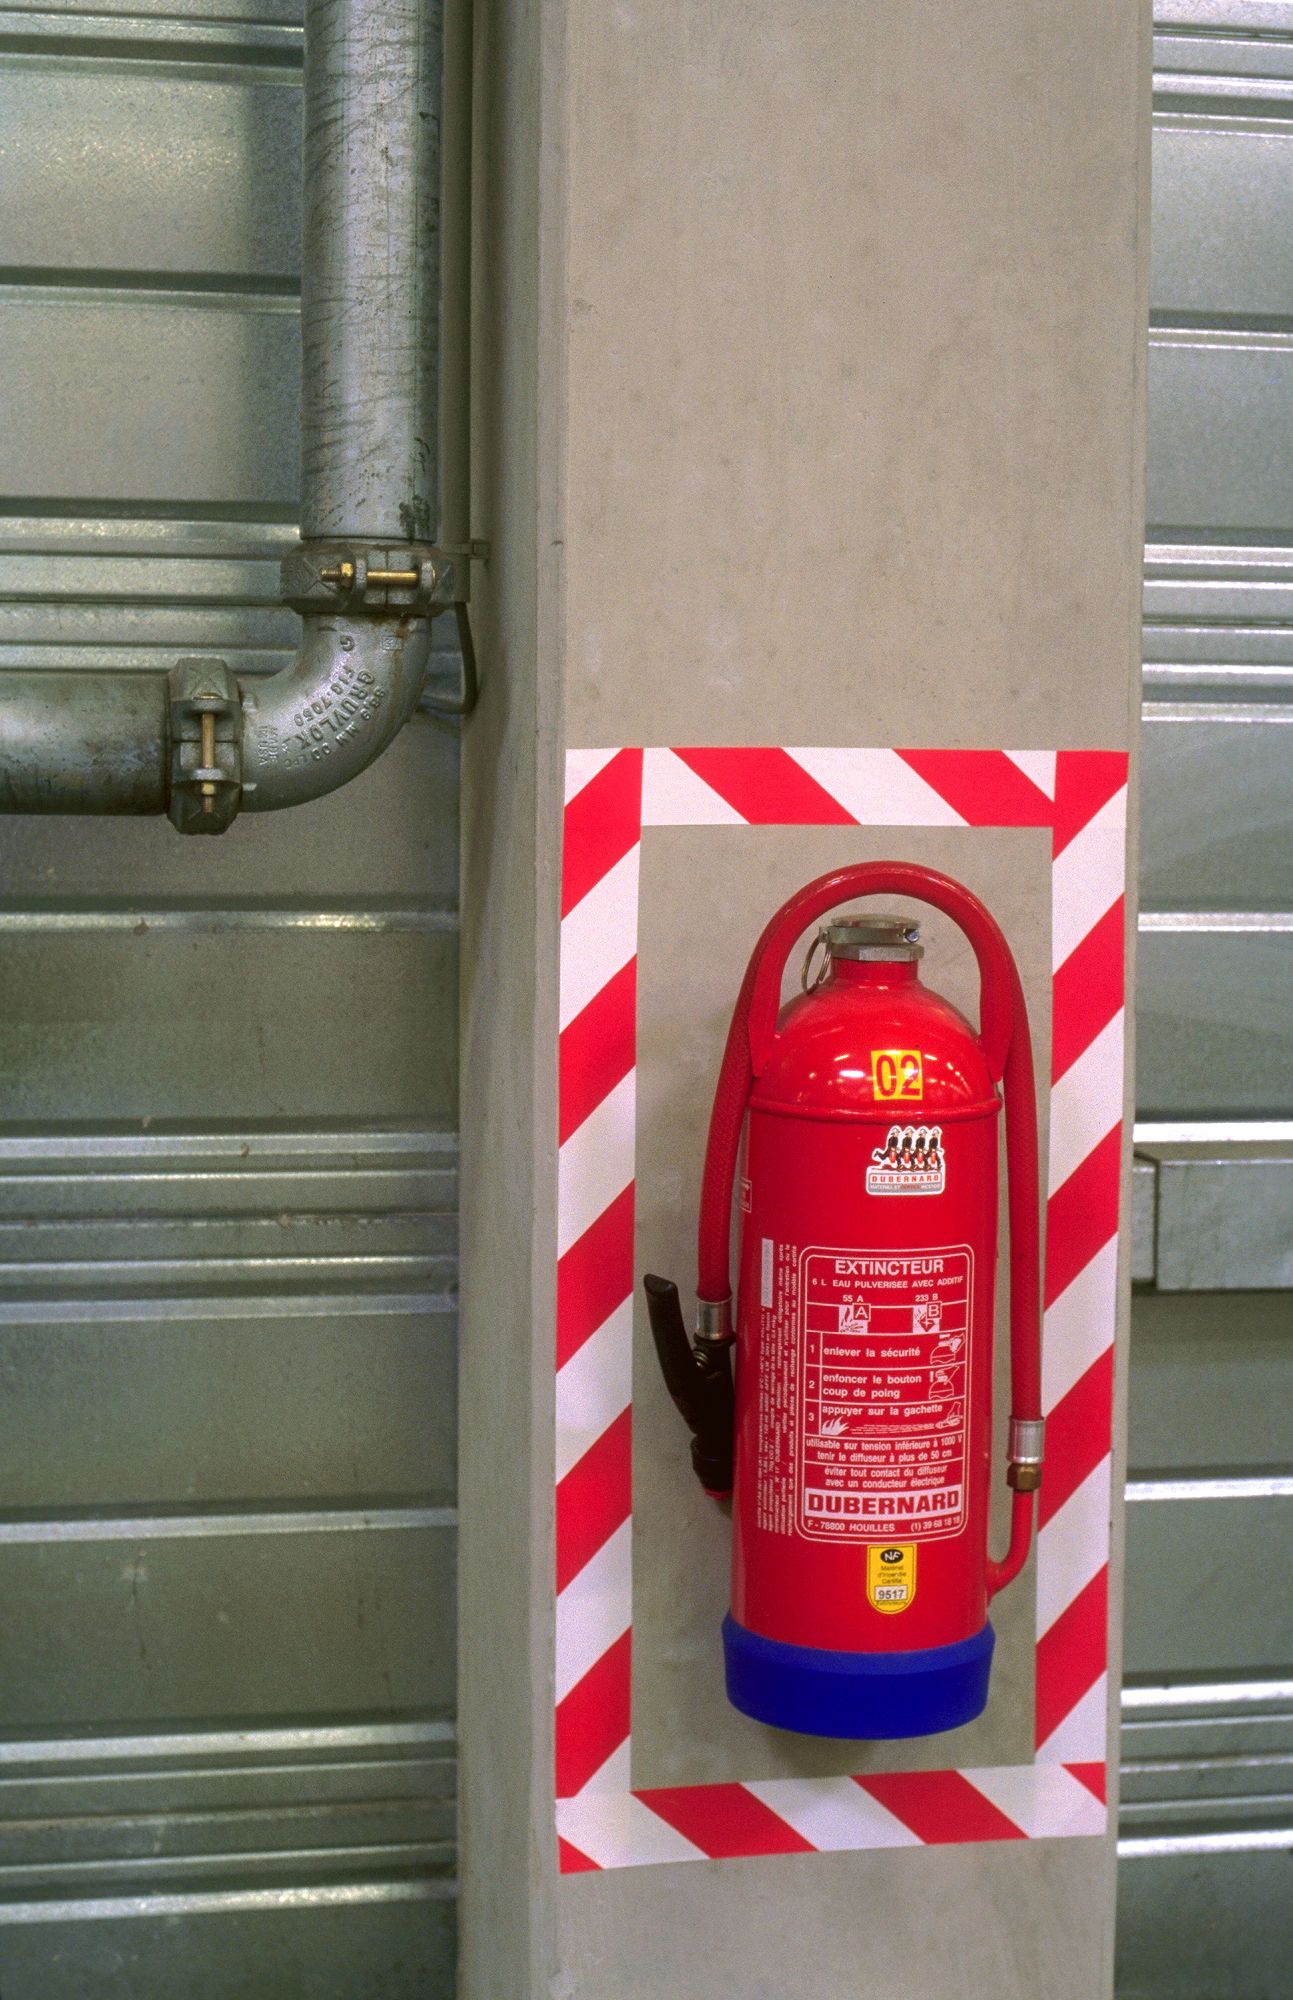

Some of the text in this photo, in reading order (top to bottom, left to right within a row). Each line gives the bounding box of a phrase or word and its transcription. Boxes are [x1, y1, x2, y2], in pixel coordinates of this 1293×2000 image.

[296, 671, 375, 749] GRUVLOK
[876, 1054, 920, 1097] 02
[871, 1174, 939, 1183] DUBERNARD
[835, 1258, 944, 1276] EXTINCTEUR
[833, 1279, 850, 1288] EAU
[854, 1280, 908, 1289] PULVERISEE
[912, 1279, 934, 1288] AVEC
[937, 1276, 963, 1286] ADDITIF
[842, 1294, 864, 1303] 55 A
[915, 1294, 929, 1302] 233
[854, 1306, 869, 1319] A
[929, 1305, 940, 1318] B
[810, 1344, 815, 1354] 1
[823, 1346, 921, 1357] enlever la sécurité
[808, 1380, 815, 1388] 2
[823, 1374, 922, 1384] enfoncer le bouton
[823, 1387, 900, 1399] coup de poing
[822, 1404, 943, 1417] appuyer sur la gachette
[808, 1413, 815, 1421] 3
[806, 1434, 963, 1450] utilisable sur tension inférieure à 1000 V
[817, 1450, 952, 1463] tenir le diffuseur à plus de 50 cm
[824, 1464, 947, 1478] éviter tout contact du diffuseur
[825, 1476, 945, 1488] avec un conducteur électrique
[808, 1490, 959, 1515] DUBERNARD
[807, 1519, 813, 1528] F
[850, 1522, 895, 1532] HOUILLES
[911, 1522, 921, 1531] (1)
[922, 1521, 933, 1530] 39
[884, 1551, 901, 1561] NF
[879, 1589, 904, 1599] 9517
